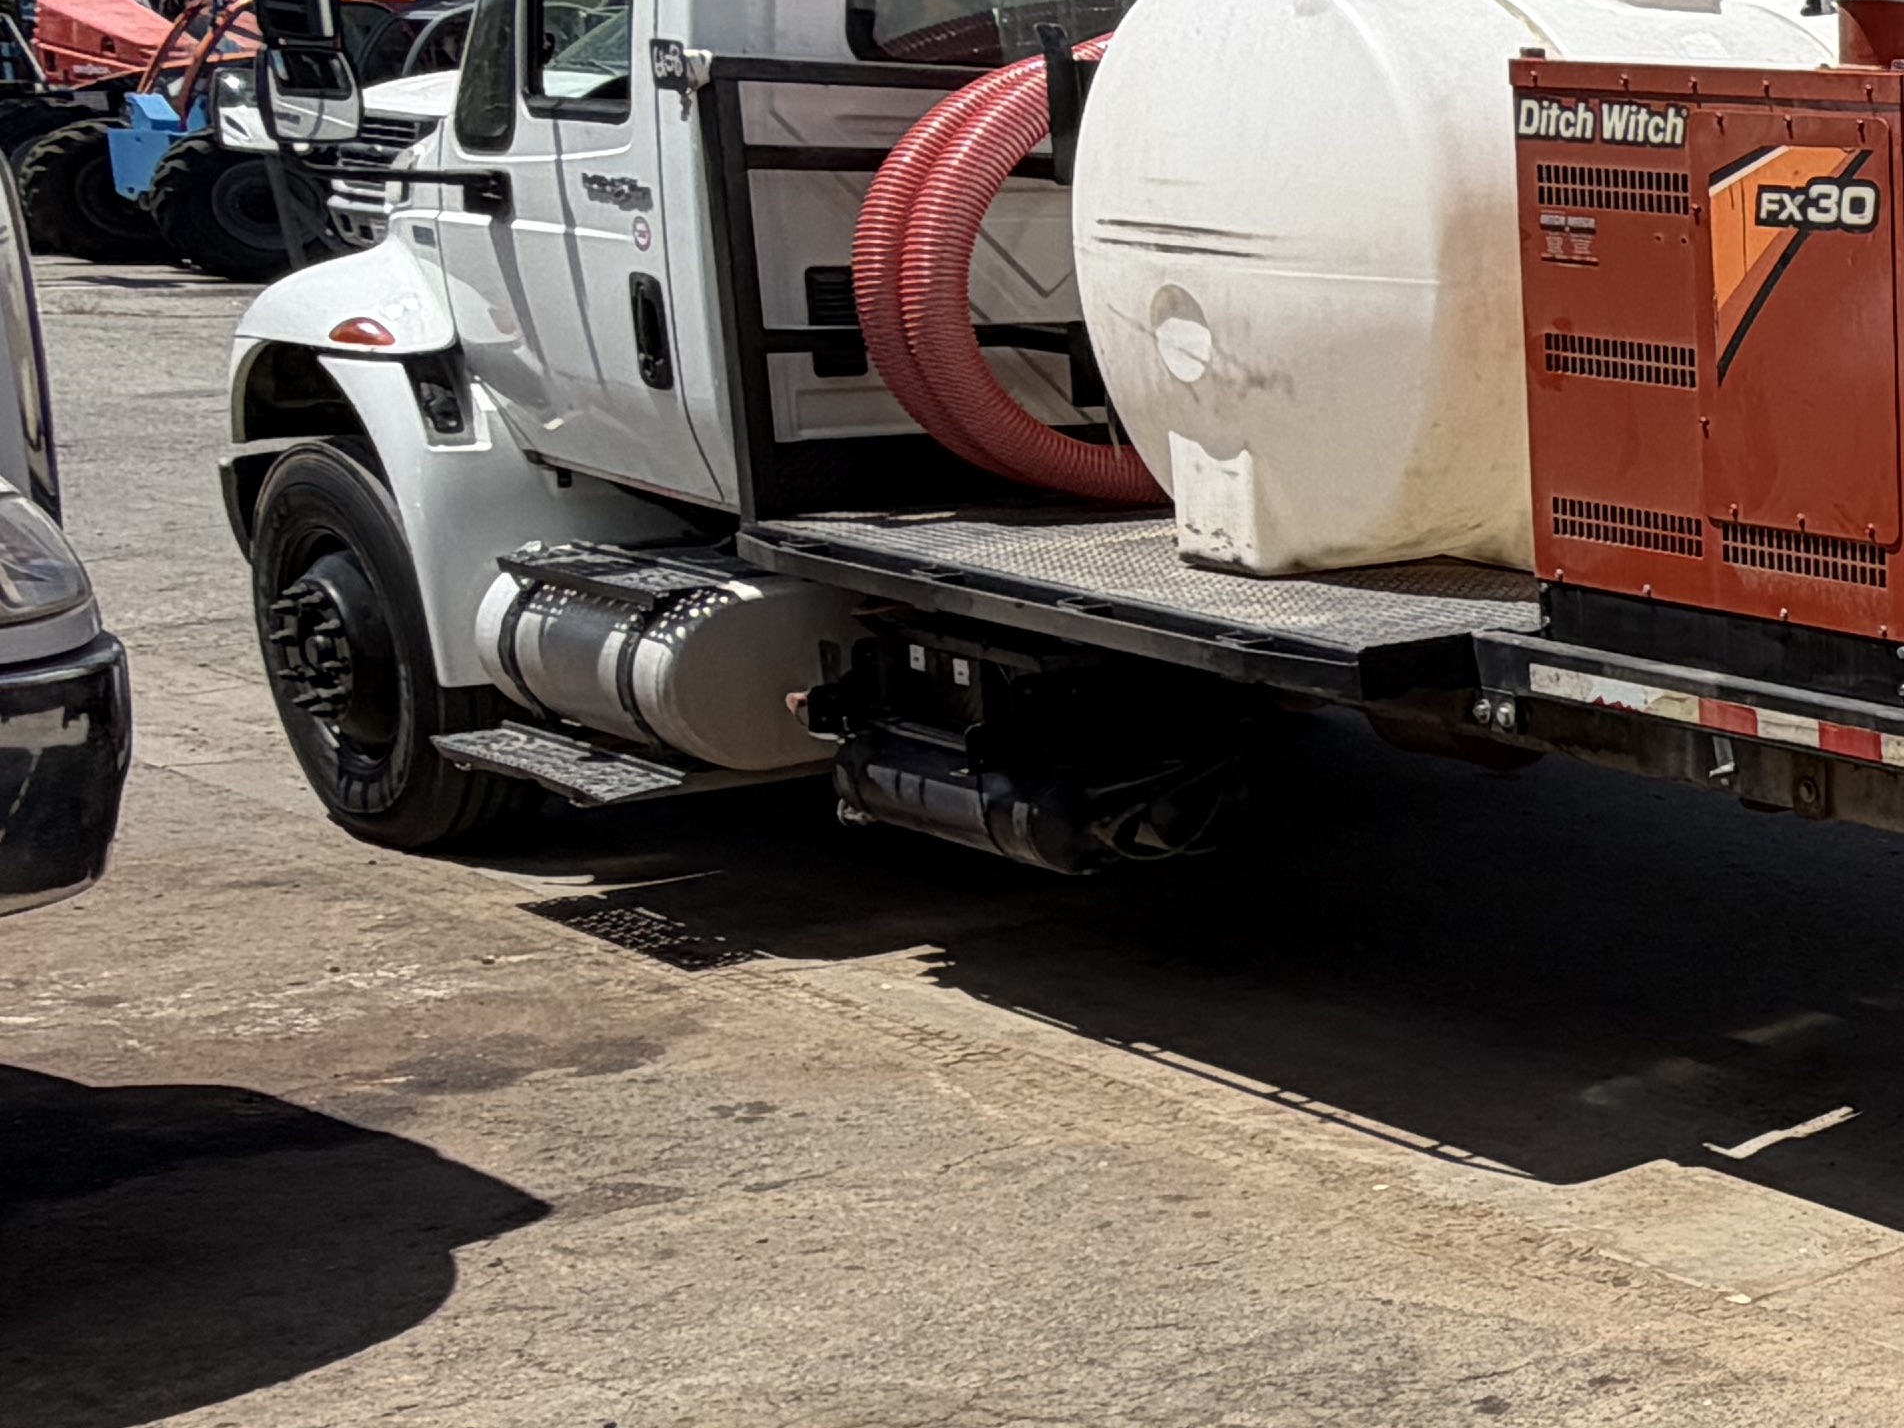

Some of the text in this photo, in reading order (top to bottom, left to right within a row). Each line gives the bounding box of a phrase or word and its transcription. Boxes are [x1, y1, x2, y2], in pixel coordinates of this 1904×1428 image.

[1518, 98, 1685, 145] Ditch Witch
[1760, 183, 1876, 226] FX30
